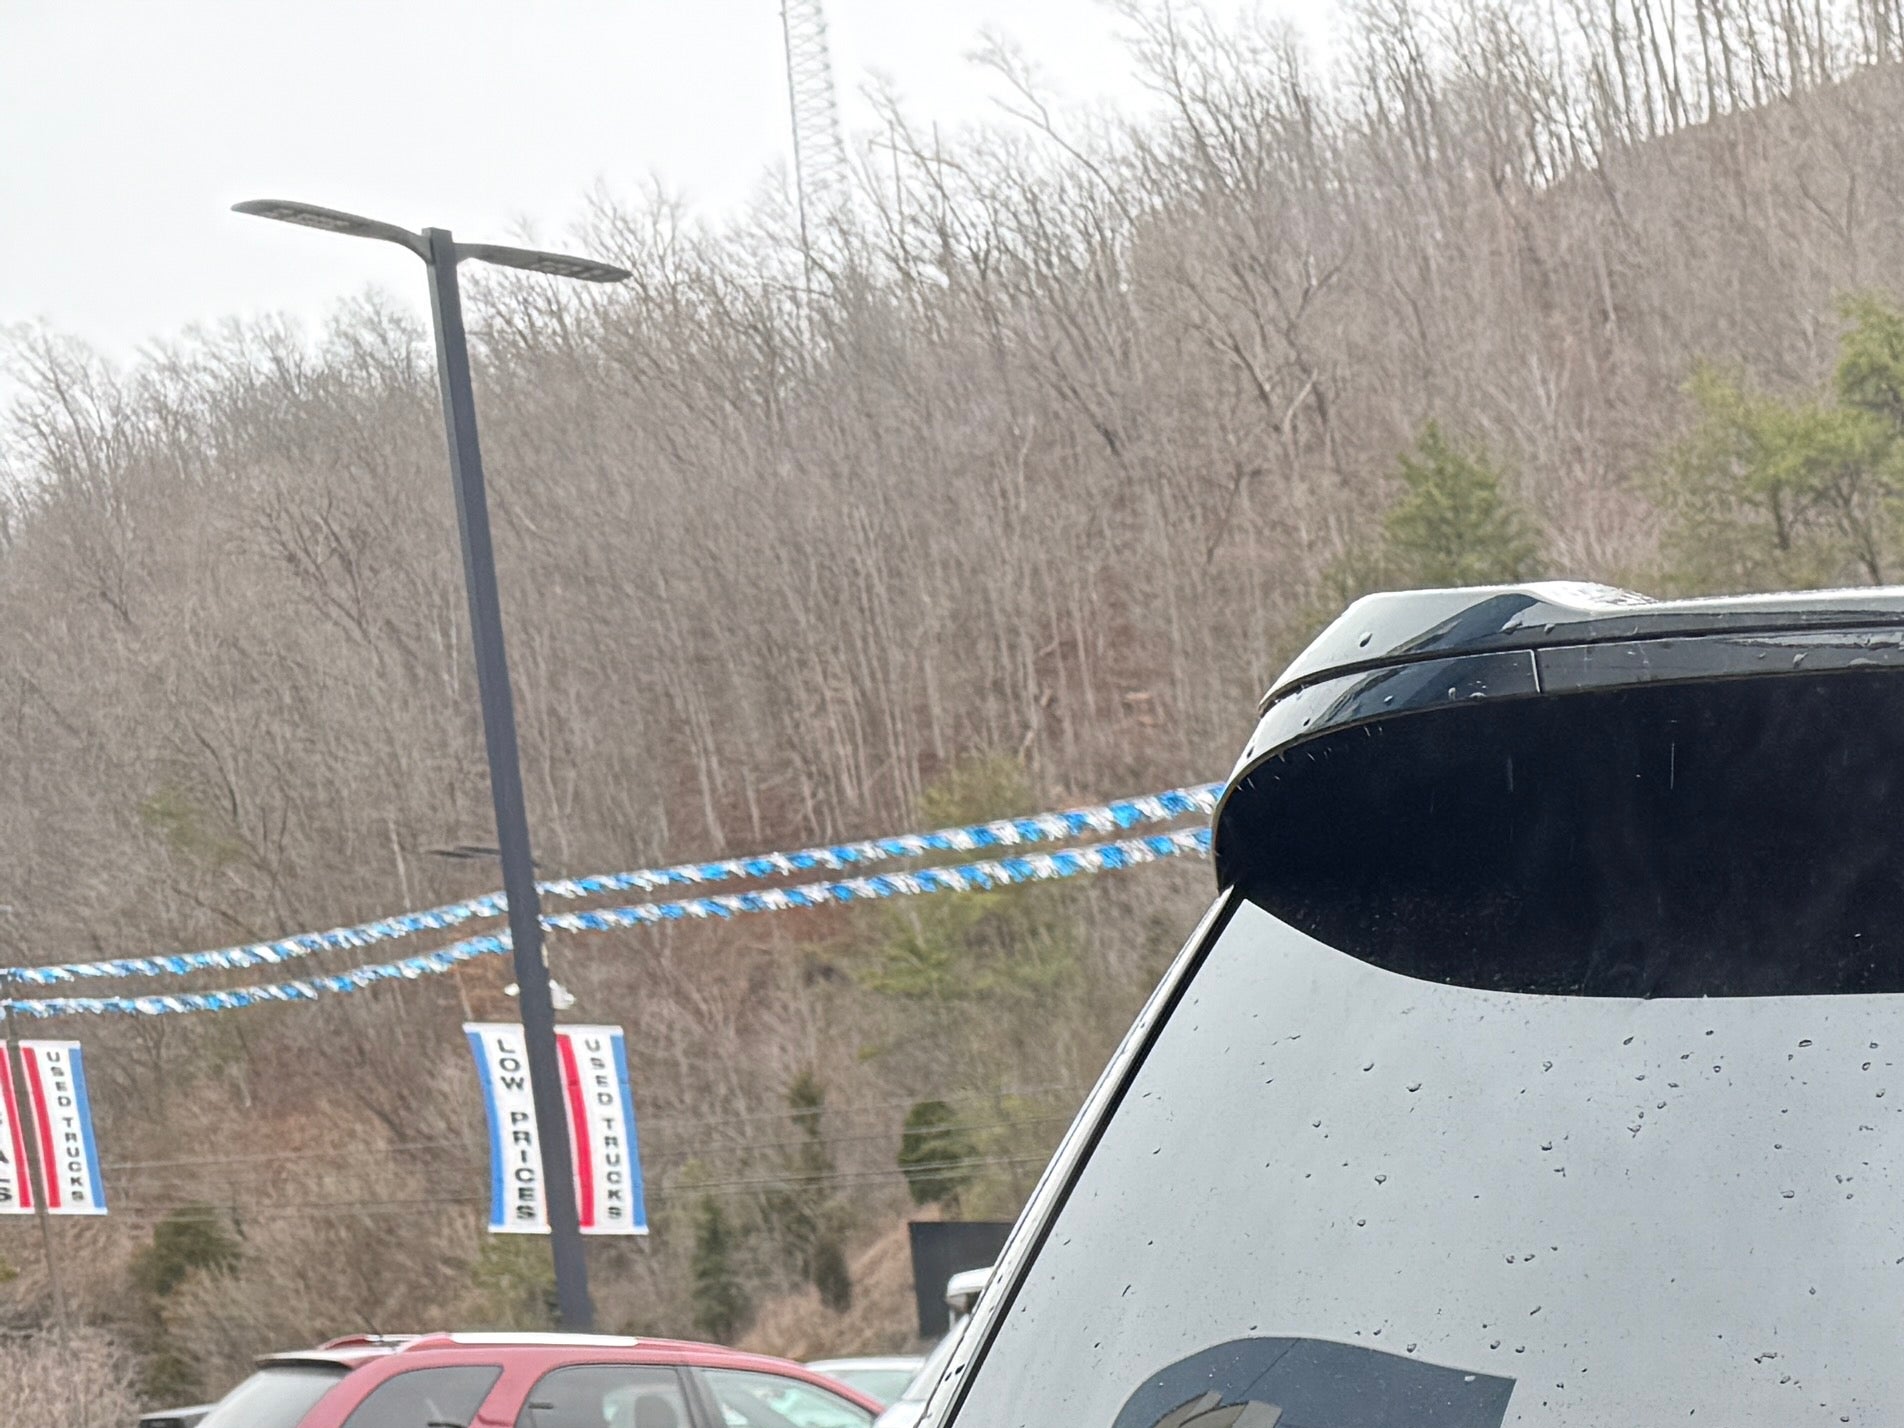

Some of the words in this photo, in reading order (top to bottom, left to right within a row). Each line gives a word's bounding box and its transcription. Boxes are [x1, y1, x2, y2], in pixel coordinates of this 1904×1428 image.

[46, 1051, 72, 1107] USED
[62, 1117, 85, 1202] TRUCKS
[496, 1037, 526, 1091] LOW
[584, 1038, 613, 1106] USED
[602, 1117, 623, 1220] TRUCKS
[510, 1110, 536, 1221] PRICES
